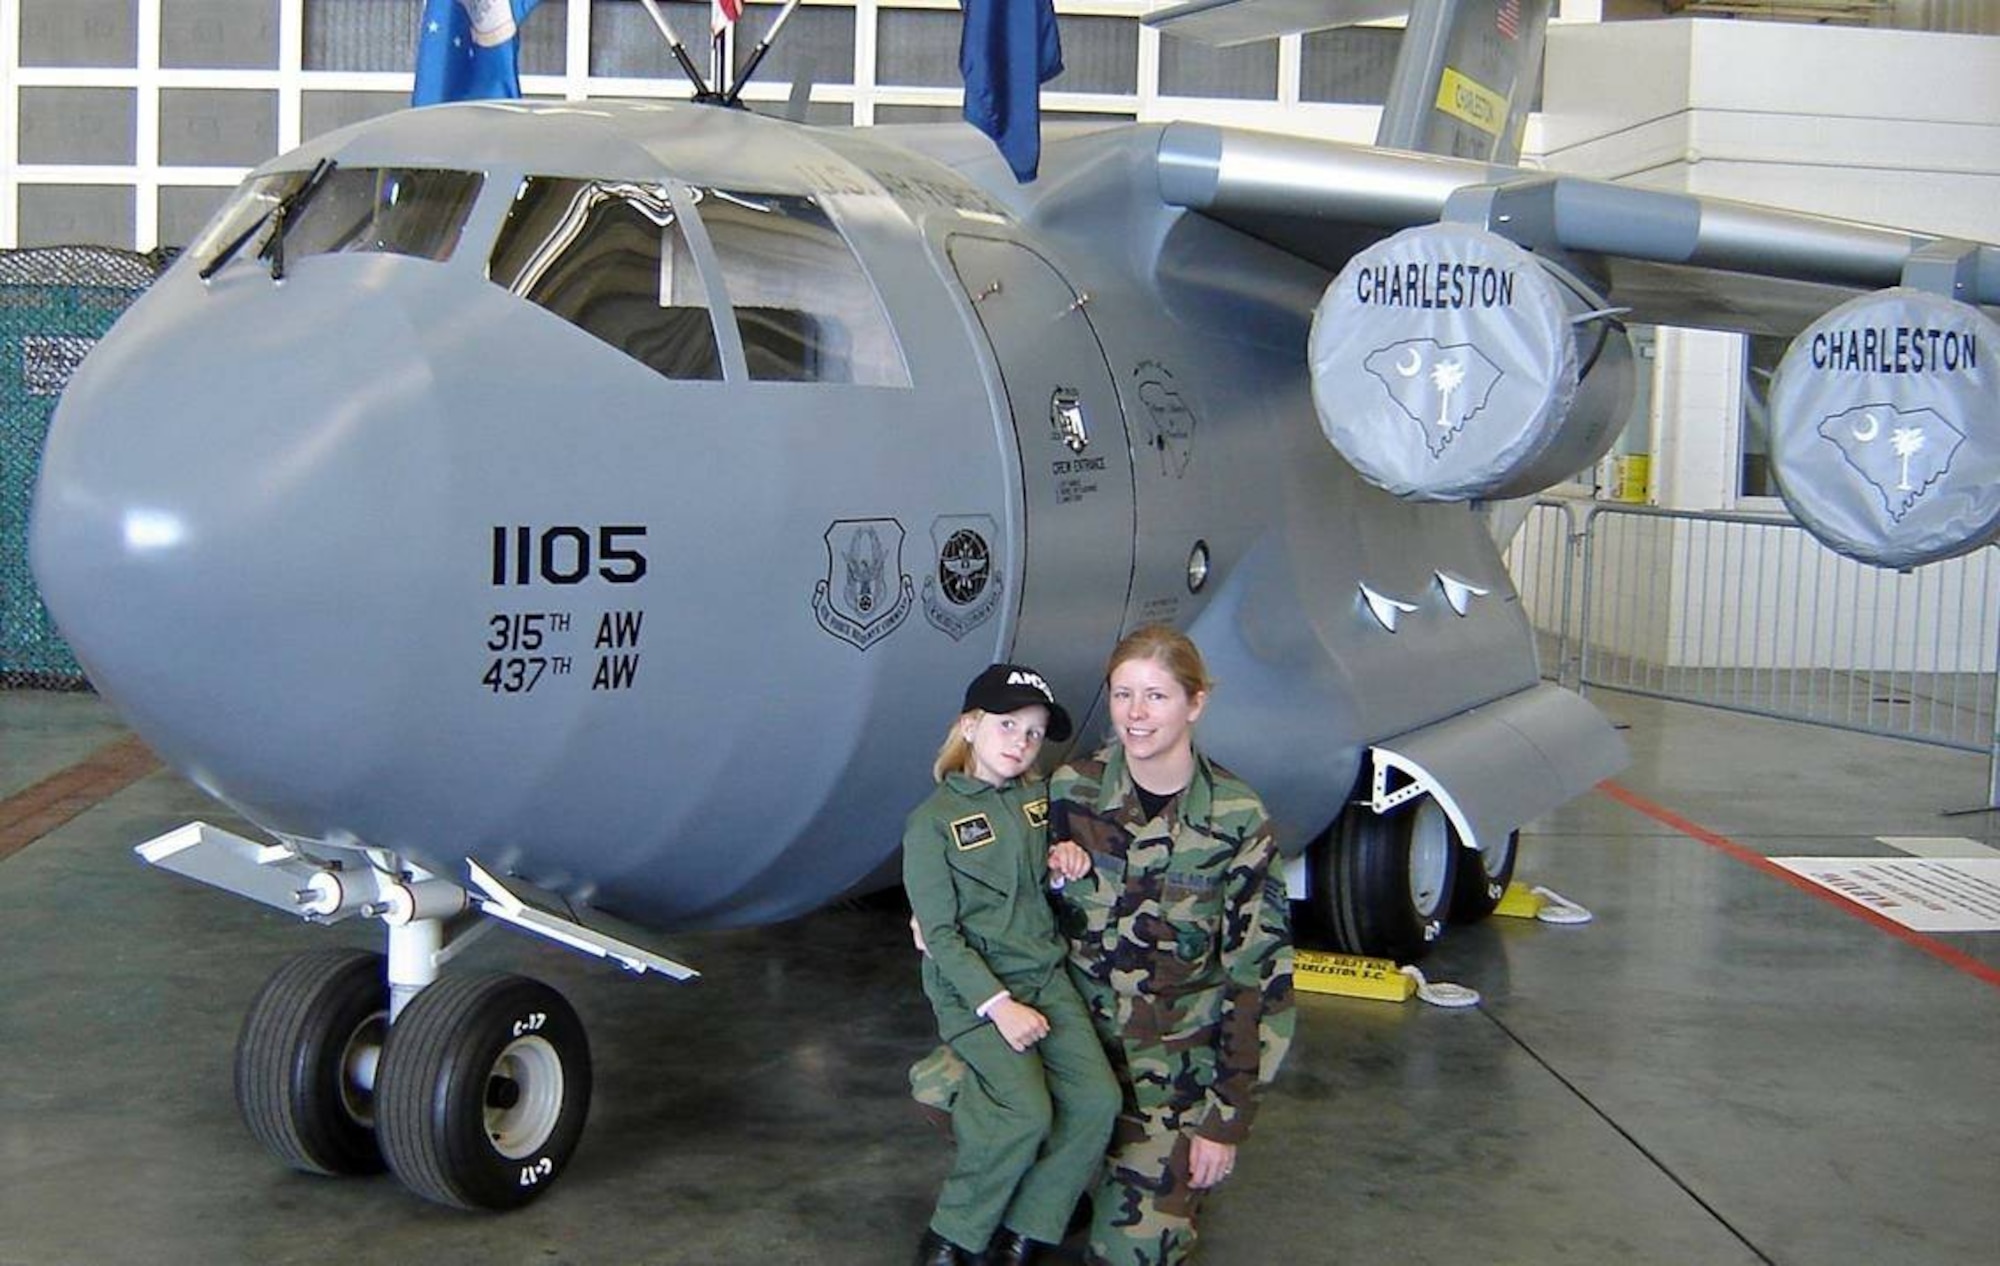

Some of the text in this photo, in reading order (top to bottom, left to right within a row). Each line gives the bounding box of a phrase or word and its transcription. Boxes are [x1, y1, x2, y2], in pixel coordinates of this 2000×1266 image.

[1357, 263, 1513, 309] CHARLESTON
[1812, 328, 1976, 373] CHARLESTON
[493, 526, 647, 585] 1105
[595, 611, 643, 649] AW
[592, 654, 639, 690] AW
[513, 1012, 546, 1037] C-17
[520, 1156, 552, 1187] C-17
